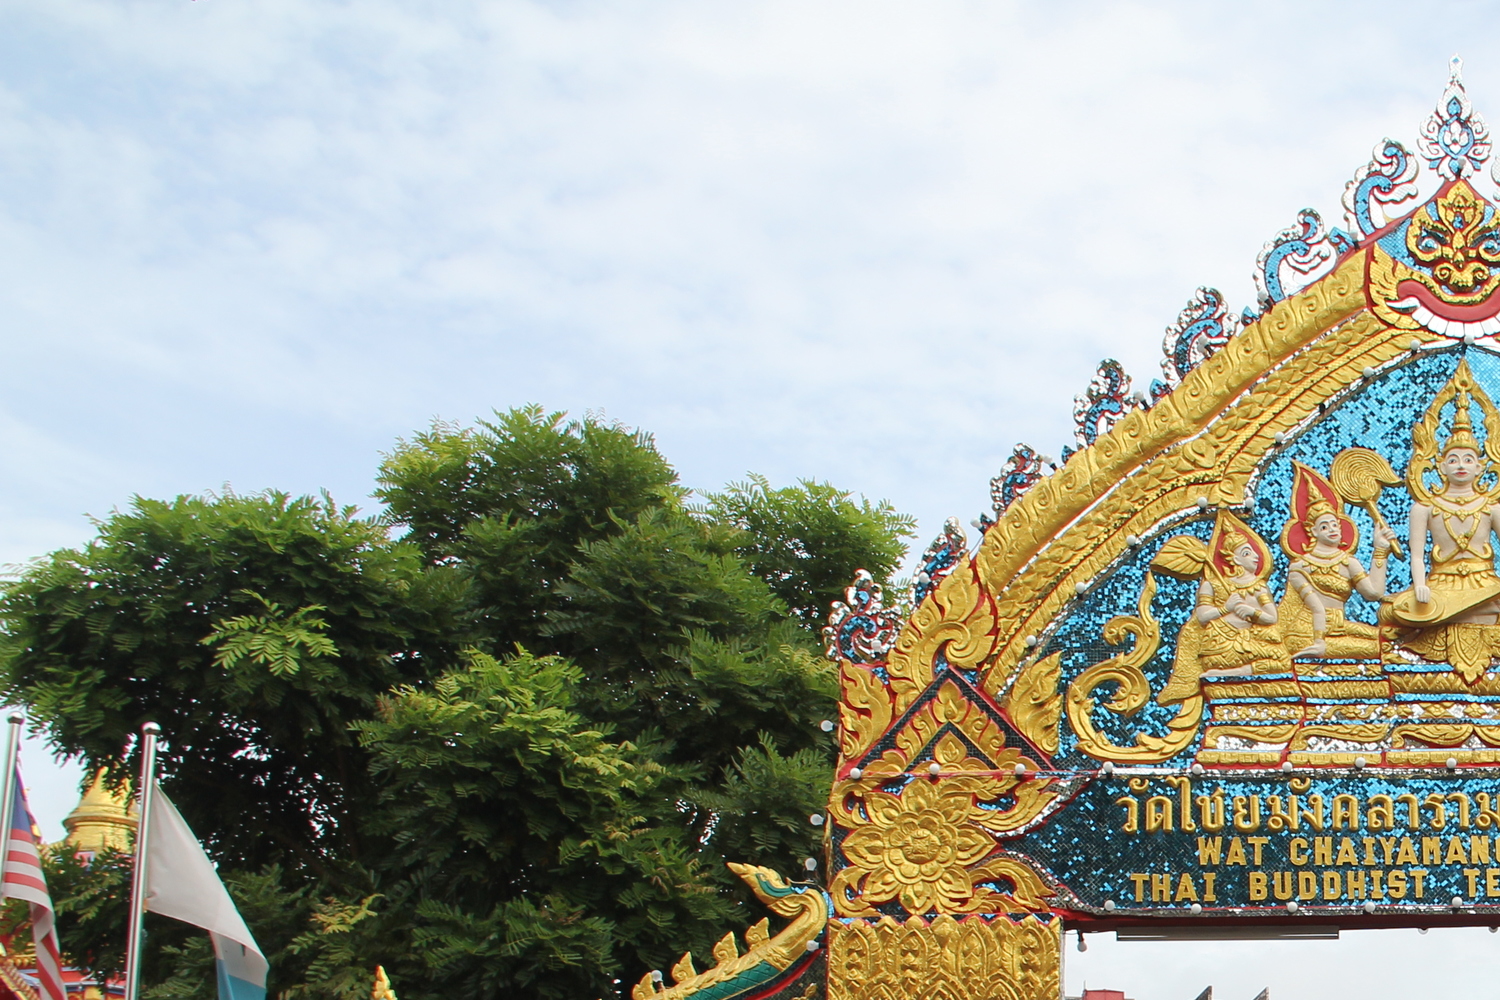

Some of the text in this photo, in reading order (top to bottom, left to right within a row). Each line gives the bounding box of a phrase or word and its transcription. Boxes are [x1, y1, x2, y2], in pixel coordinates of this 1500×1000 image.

[1197, 836, 1268, 866] WAT
[1130, 872, 1217, 902] THAI
[1250, 869, 1427, 900] BUDDHIST
